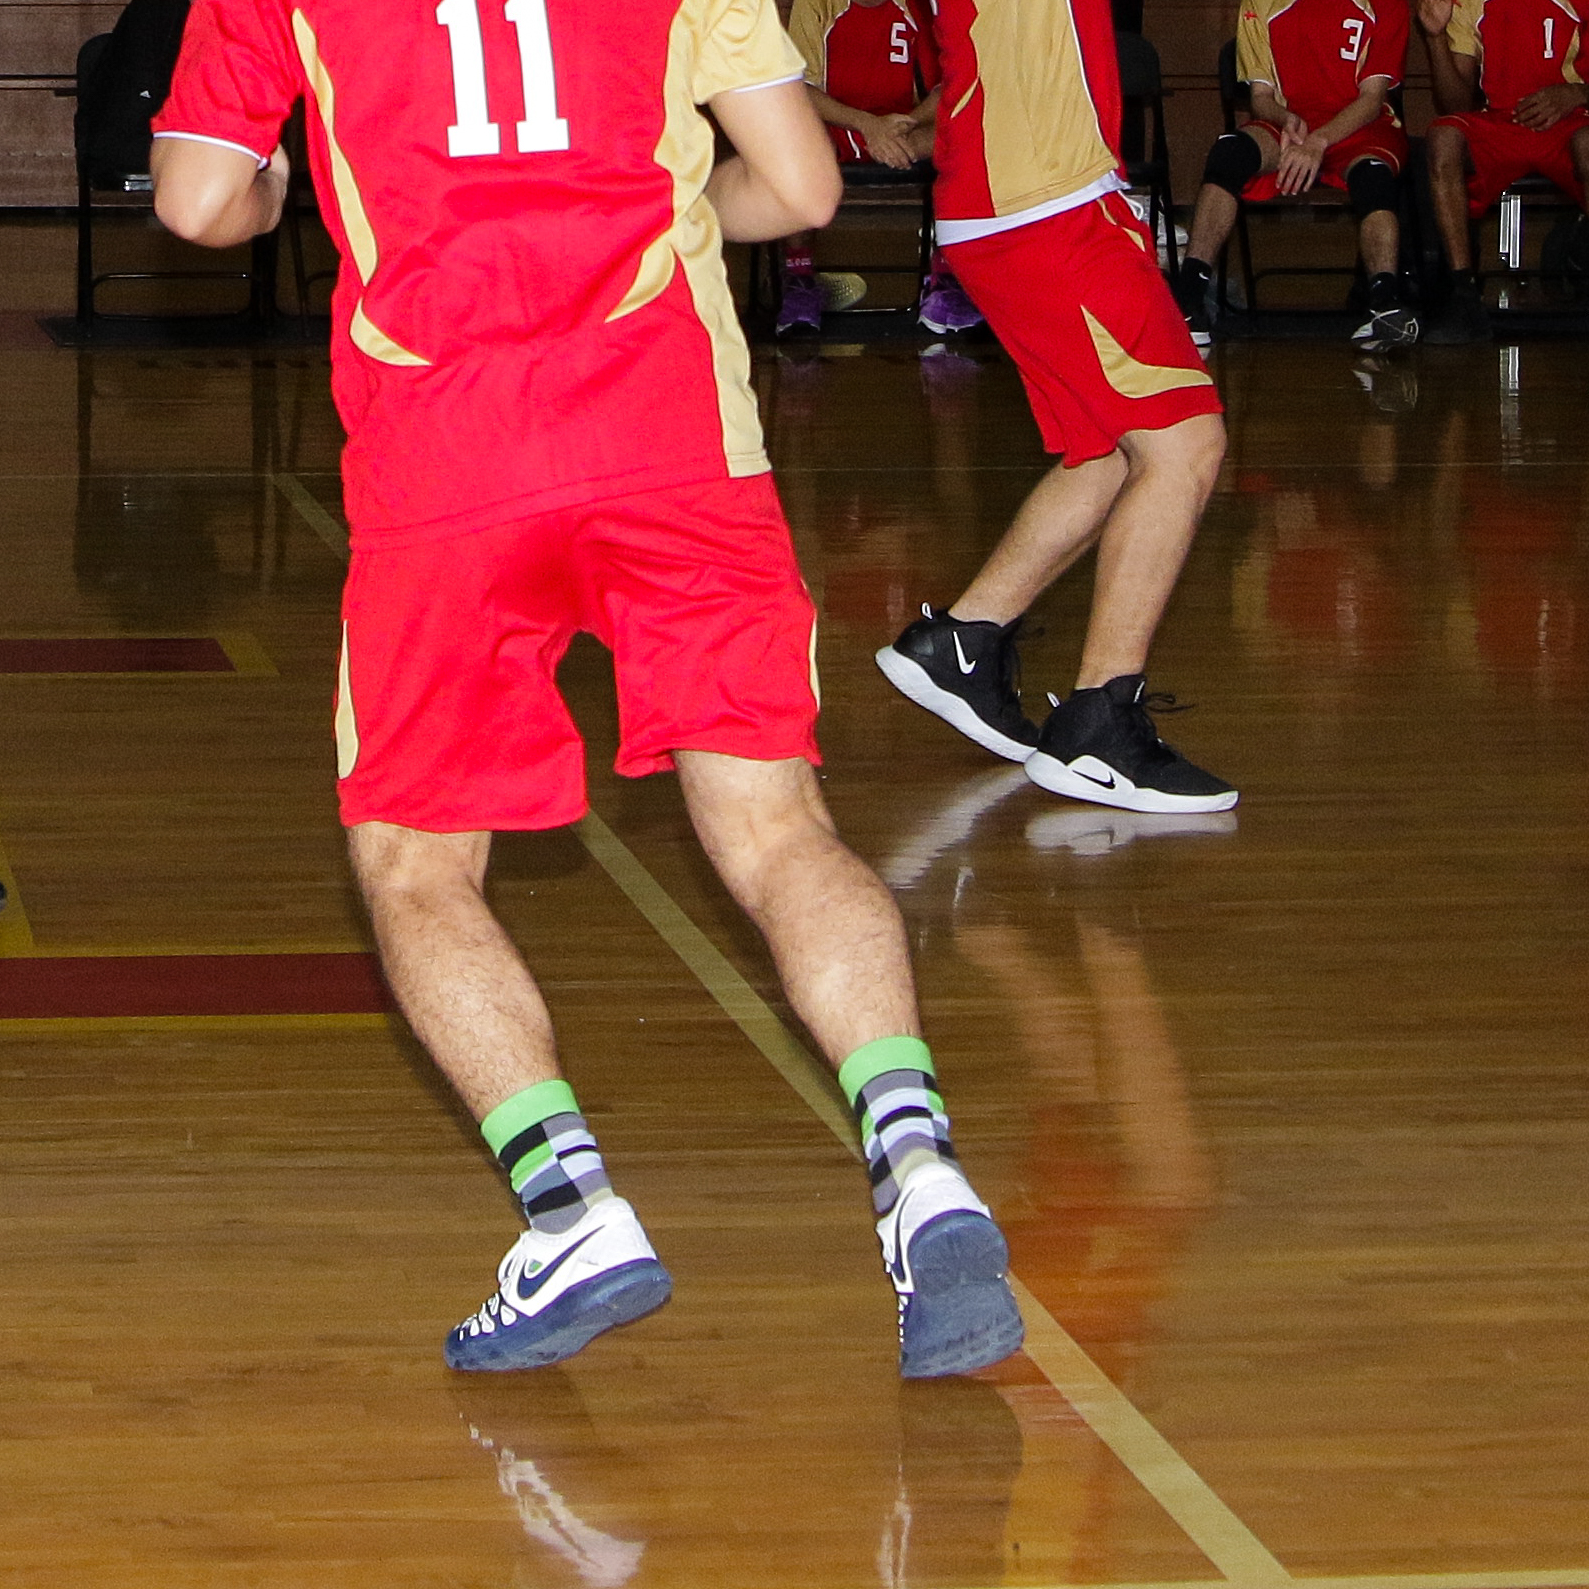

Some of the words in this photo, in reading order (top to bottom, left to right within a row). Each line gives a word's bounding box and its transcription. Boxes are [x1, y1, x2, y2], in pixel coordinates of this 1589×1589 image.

[890, 23, 909, 63] 5
[1340, 19, 1364, 61] 3
[1542, 18, 1554, 58] 1
